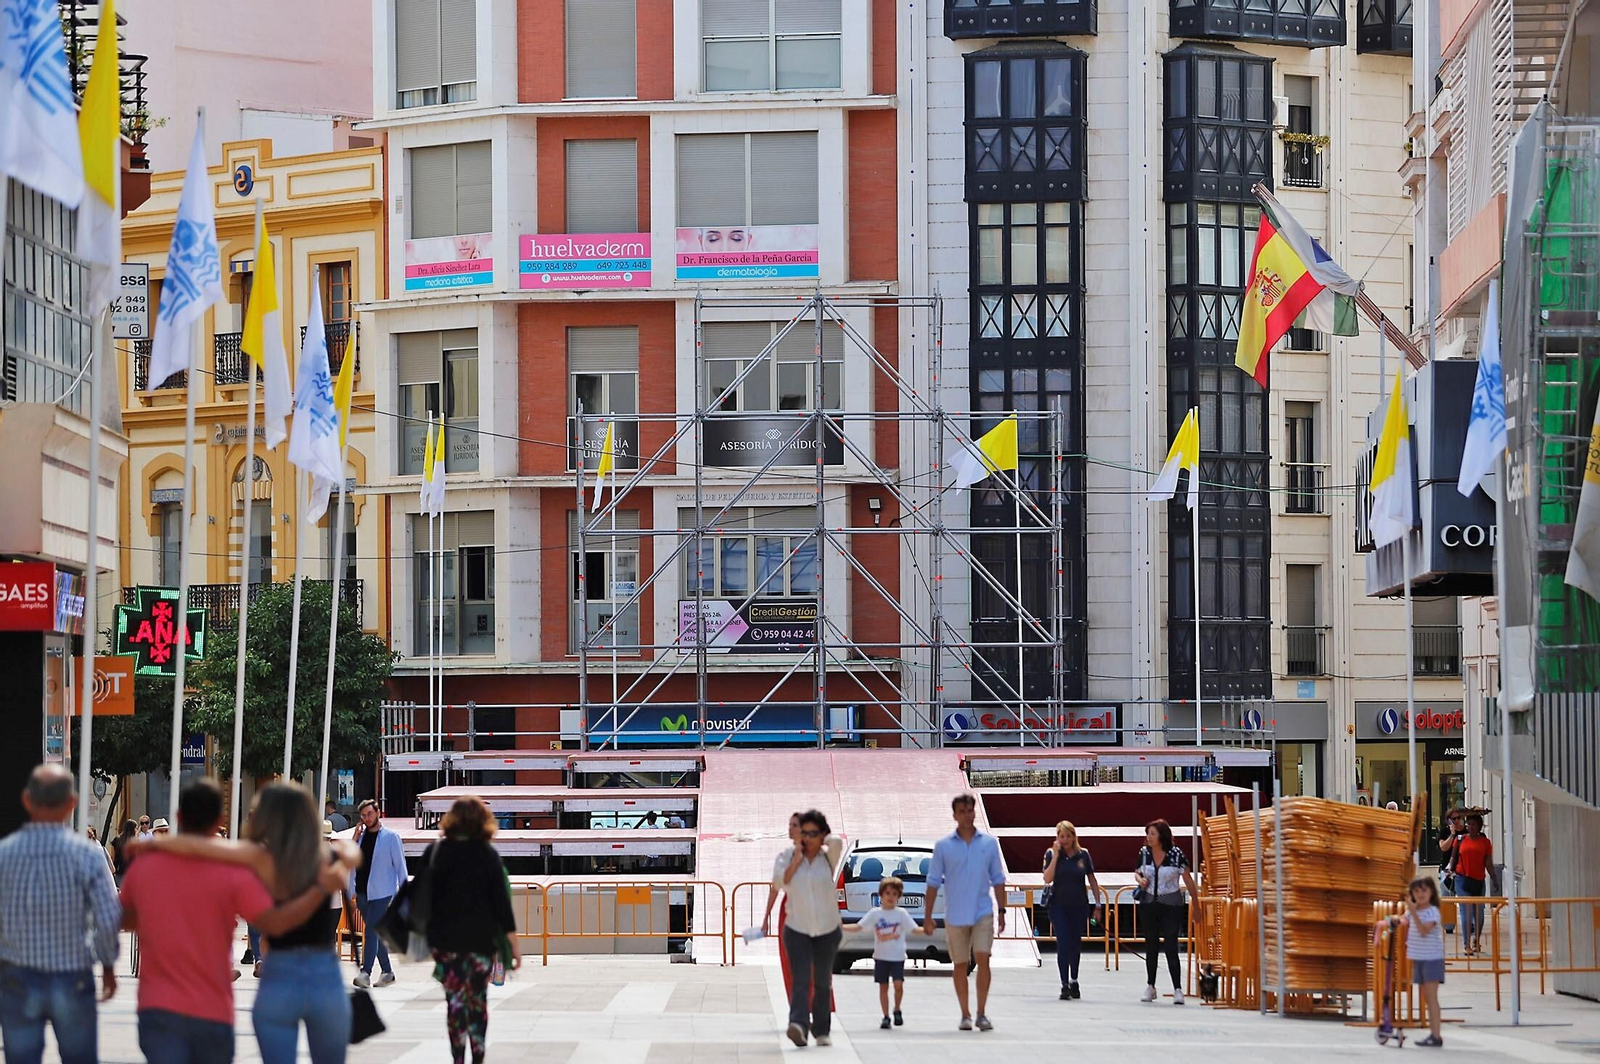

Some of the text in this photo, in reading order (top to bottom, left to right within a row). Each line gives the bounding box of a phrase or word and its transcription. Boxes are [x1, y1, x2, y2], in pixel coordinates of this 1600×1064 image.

[530, 239, 644, 257] huelvaderm
[683, 255, 697, 264] Dr.
[698, 254, 739, 264] Francisco
[741, 254, 751, 263] de
[752, 254, 760, 263] la
[762, 253, 783, 263] Peña
[527, 262, 542, 271] 959
[544, 262, 560, 270] 284
[562, 262, 578, 270] 289
[596, 261, 612, 269] 649
[631, 260, 648, 268] 448
[552, 273, 622, 281] www.huelvaderm.com
[125, 295, 146, 303] 949
[720, 439, 772, 451] ASESORÍA
[752, 606, 817, 616] CreditGestión
[764, 629, 780, 638] 959
[781, 629, 792, 638] 04
[793, 629, 804, 638] 42
[904, 897, 919, 905] DYR
